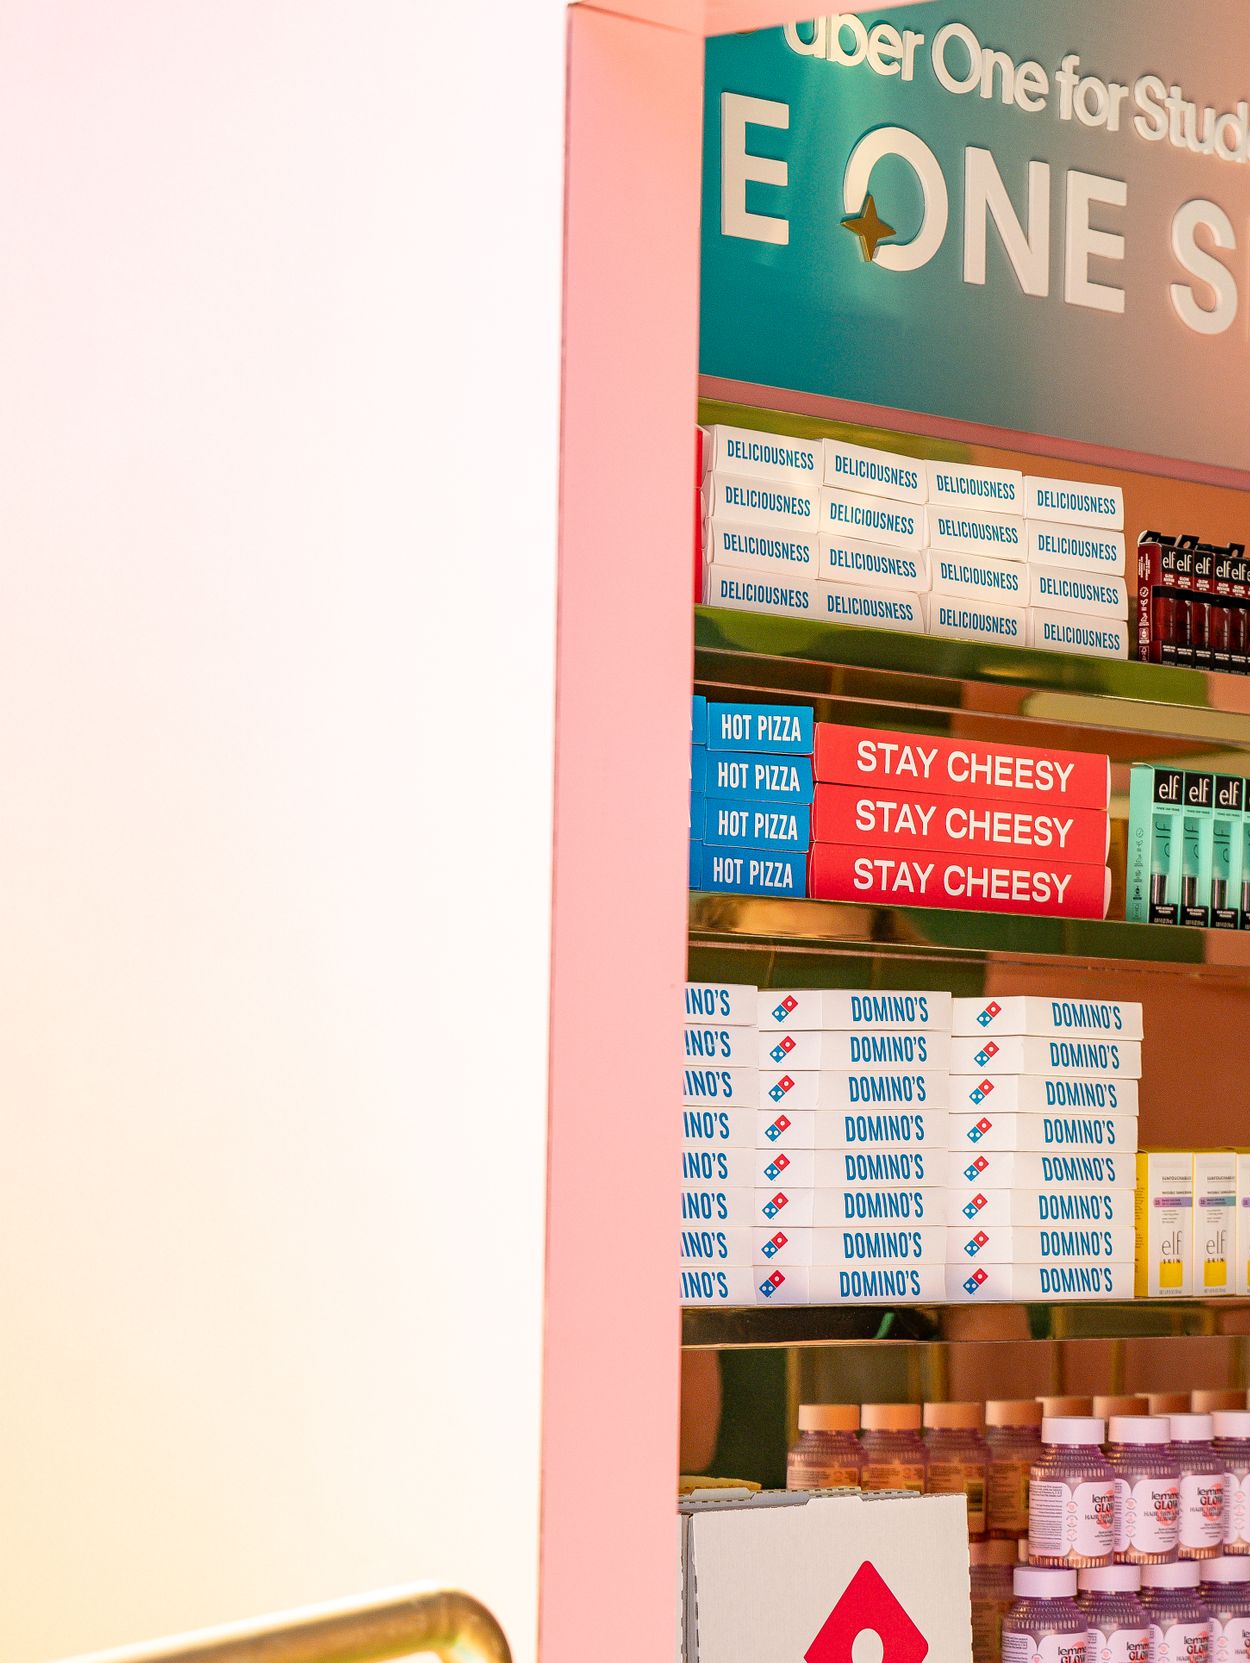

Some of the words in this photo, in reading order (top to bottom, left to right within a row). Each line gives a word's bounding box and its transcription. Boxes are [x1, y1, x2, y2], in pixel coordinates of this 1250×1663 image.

[932, 22, 1049, 112] One
[1055, 54, 1128, 131] for
[841, 126, 1127, 313] ONE
[727, 439, 814, 470] DELICIOUSNESS
[835, 455, 918, 489] DELICIOUSNESS
[937, 474, 1015, 500] DELICIOUSNESS
[725, 486, 811, 517] DELICIOUSNESS
[1037, 489, 1116, 515] DELICIOUSNESS
[830, 502, 914, 535] DELICIOUSNESS
[938, 519, 1018, 544] DELICIOUSNESS
[723, 533, 810, 563] DELICIOUSNESS
[1038, 534, 1117, 561] DELICIOUSNESS
[1163, 552, 1175, 569] elf
[829, 548, 916, 578] DELICIOUSNESS
[941, 562, 1018, 591] DELICIOUSNESS
[1177, 554, 1192, 572] elf
[1196, 557, 1211, 575] elf
[1216, 561, 1231, 578] elf
[1232, 563, 1246, 580] elf
[720, 580, 809, 609] DELICIOUSNESS
[1040, 577, 1119, 604] DELICIOUSNESS
[827, 594, 913, 621] DELICIOUSNESS
[939, 607, 1017, 636] DELICIOUSNESS
[1044, 623, 1120, 650] DELICIOUSNESS
[721, 713, 751, 740] HOT
[757, 716, 801, 742] PIZZA
[718, 762, 749, 788] HOT
[755, 765, 800, 792] PIZZA
[857, 740, 938, 778] STAY
[947, 750, 1075, 793] CHEESY
[1159, 775, 1180, 800] elf
[1189, 778, 1210, 802] elf
[1219, 781, 1239, 806] elf
[718, 810, 749, 838] HOT
[756, 812, 797, 841] PIZZA
[855, 799, 936, 838] STAY
[945, 808, 1073, 848] CHEESY
[713, 857, 744, 884] HOT
[749, 861, 793, 888] PIZZA
[853, 858, 934, 893] STAY
[943, 865, 1072, 904] CHEESY
[851, 997, 929, 1022] DOMINO'S
[1052, 1002, 1123, 1030] DOMINO'S
[851, 1036, 927, 1062] DOMINO'S
[1050, 1042, 1120, 1069] DOMINO'S
[683, 1071, 732, 1098] INO'S
[848, 1076, 926, 1102] DOMINO'S
[1045, 1081, 1118, 1108] DOMINO'S
[845, 1115, 925, 1142] DOMINO'S
[1043, 1118, 1116, 1145] DOMINO'S
[845, 1155, 924, 1180] DOMINO'S
[1042, 1157, 1116, 1182] DOMINO'S
[844, 1192, 924, 1218] DOMINO'S
[1039, 1195, 1113, 1220] DOMINO'S
[681, 1232, 728, 1258] INO'S
[843, 1232, 922, 1258] DOMINO'S
[1040, 1231, 1113, 1257] DOMINO'S
[1162, 1230, 1182, 1255] elf
[1206, 1230, 1226, 1254] elf
[681, 1272, 728, 1298] INO'S
[839, 1270, 920, 1297] DOMINO'S
[1040, 1268, 1113, 1293] DOMINO'S
